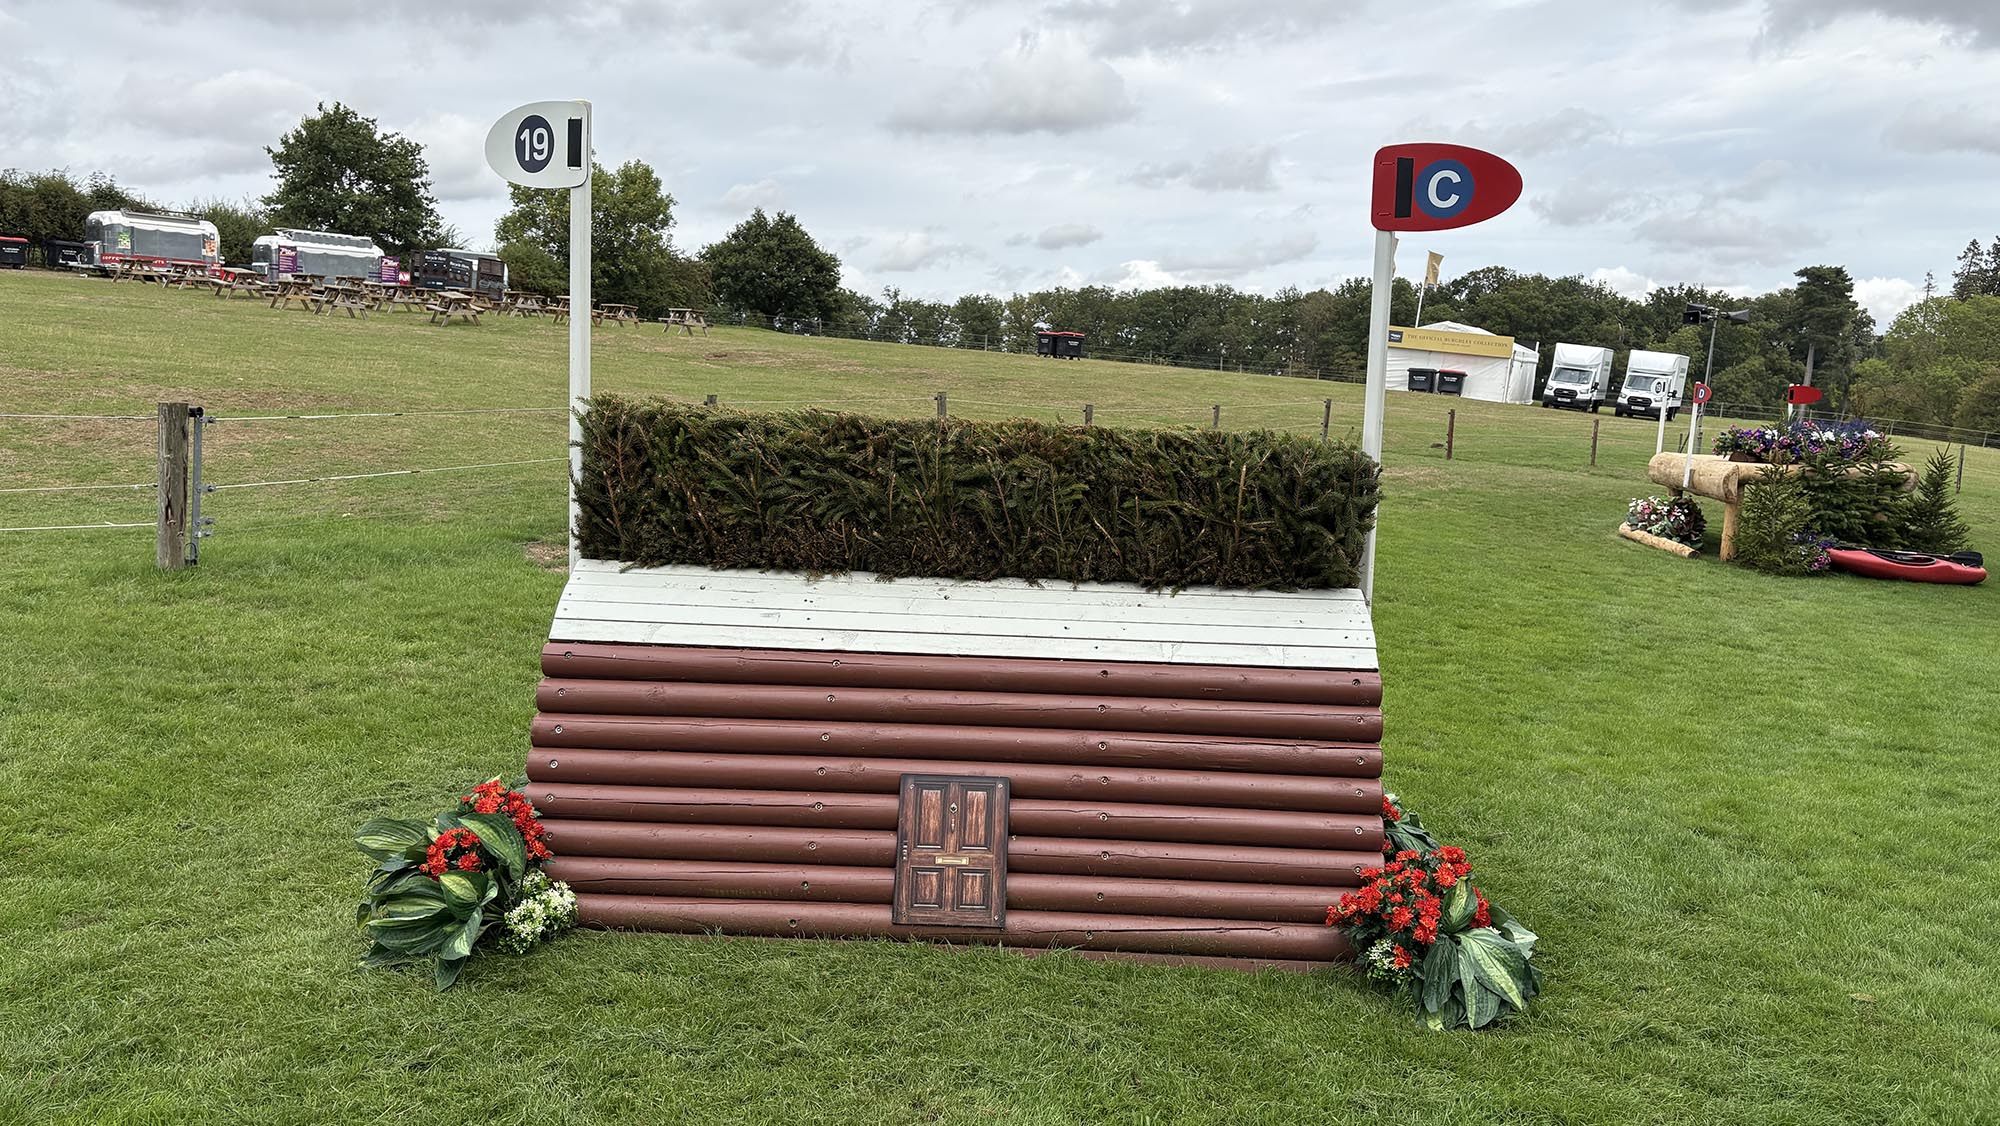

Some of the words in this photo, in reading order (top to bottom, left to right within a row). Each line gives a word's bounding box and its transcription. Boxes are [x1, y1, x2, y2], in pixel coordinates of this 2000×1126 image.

[519, 127, 549, 162] 19
[1427, 169, 1462, 209] C
[1444, 337, 1472, 345] BURGHLEY
[1473, 339, 1508, 348] COLLECTION
[1698, 388, 1705, 399] D
